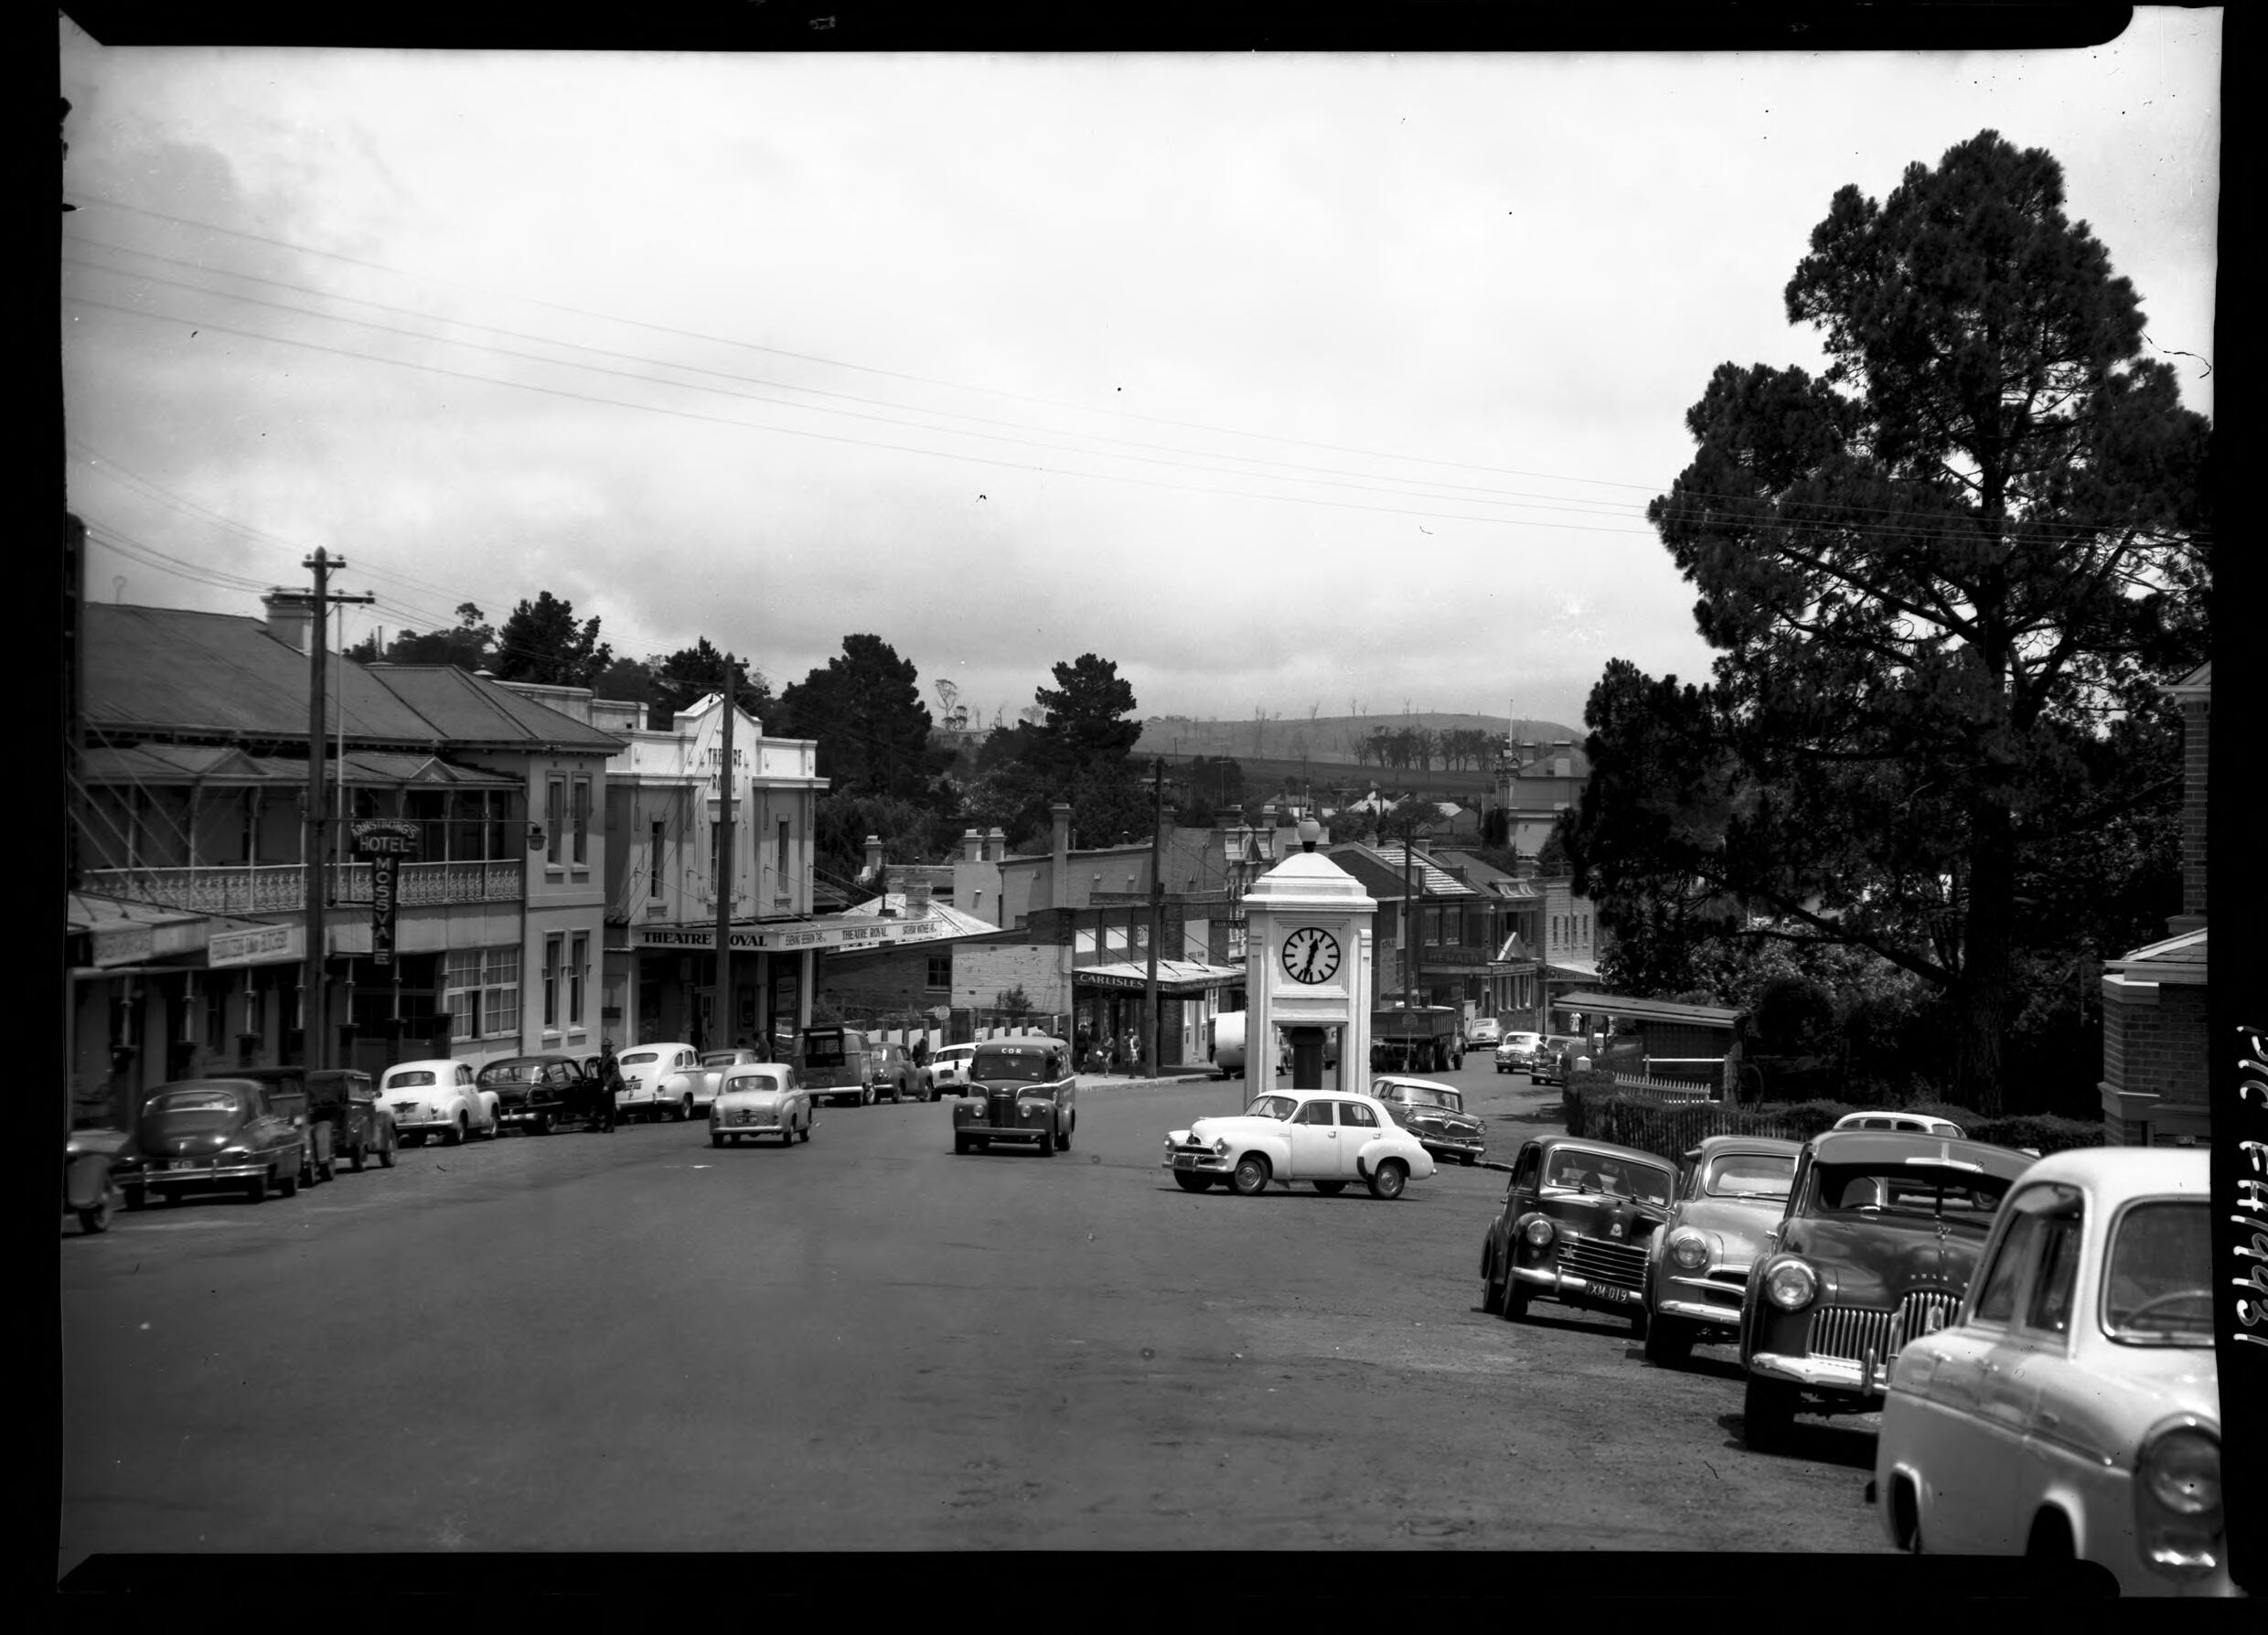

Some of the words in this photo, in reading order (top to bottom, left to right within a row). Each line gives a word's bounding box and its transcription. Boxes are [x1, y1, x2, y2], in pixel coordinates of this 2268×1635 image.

[708, 748, 742, 766] THERE
[359, 837, 410, 851] HOTEL
[643, 932, 711, 946] THEATRE
[729, 935, 767, 947] OYAL
[841, 928, 867, 940] THEATRE
[870, 926, 888, 938] ROYAL
[1079, 973, 1144, 988] CARLISLES
